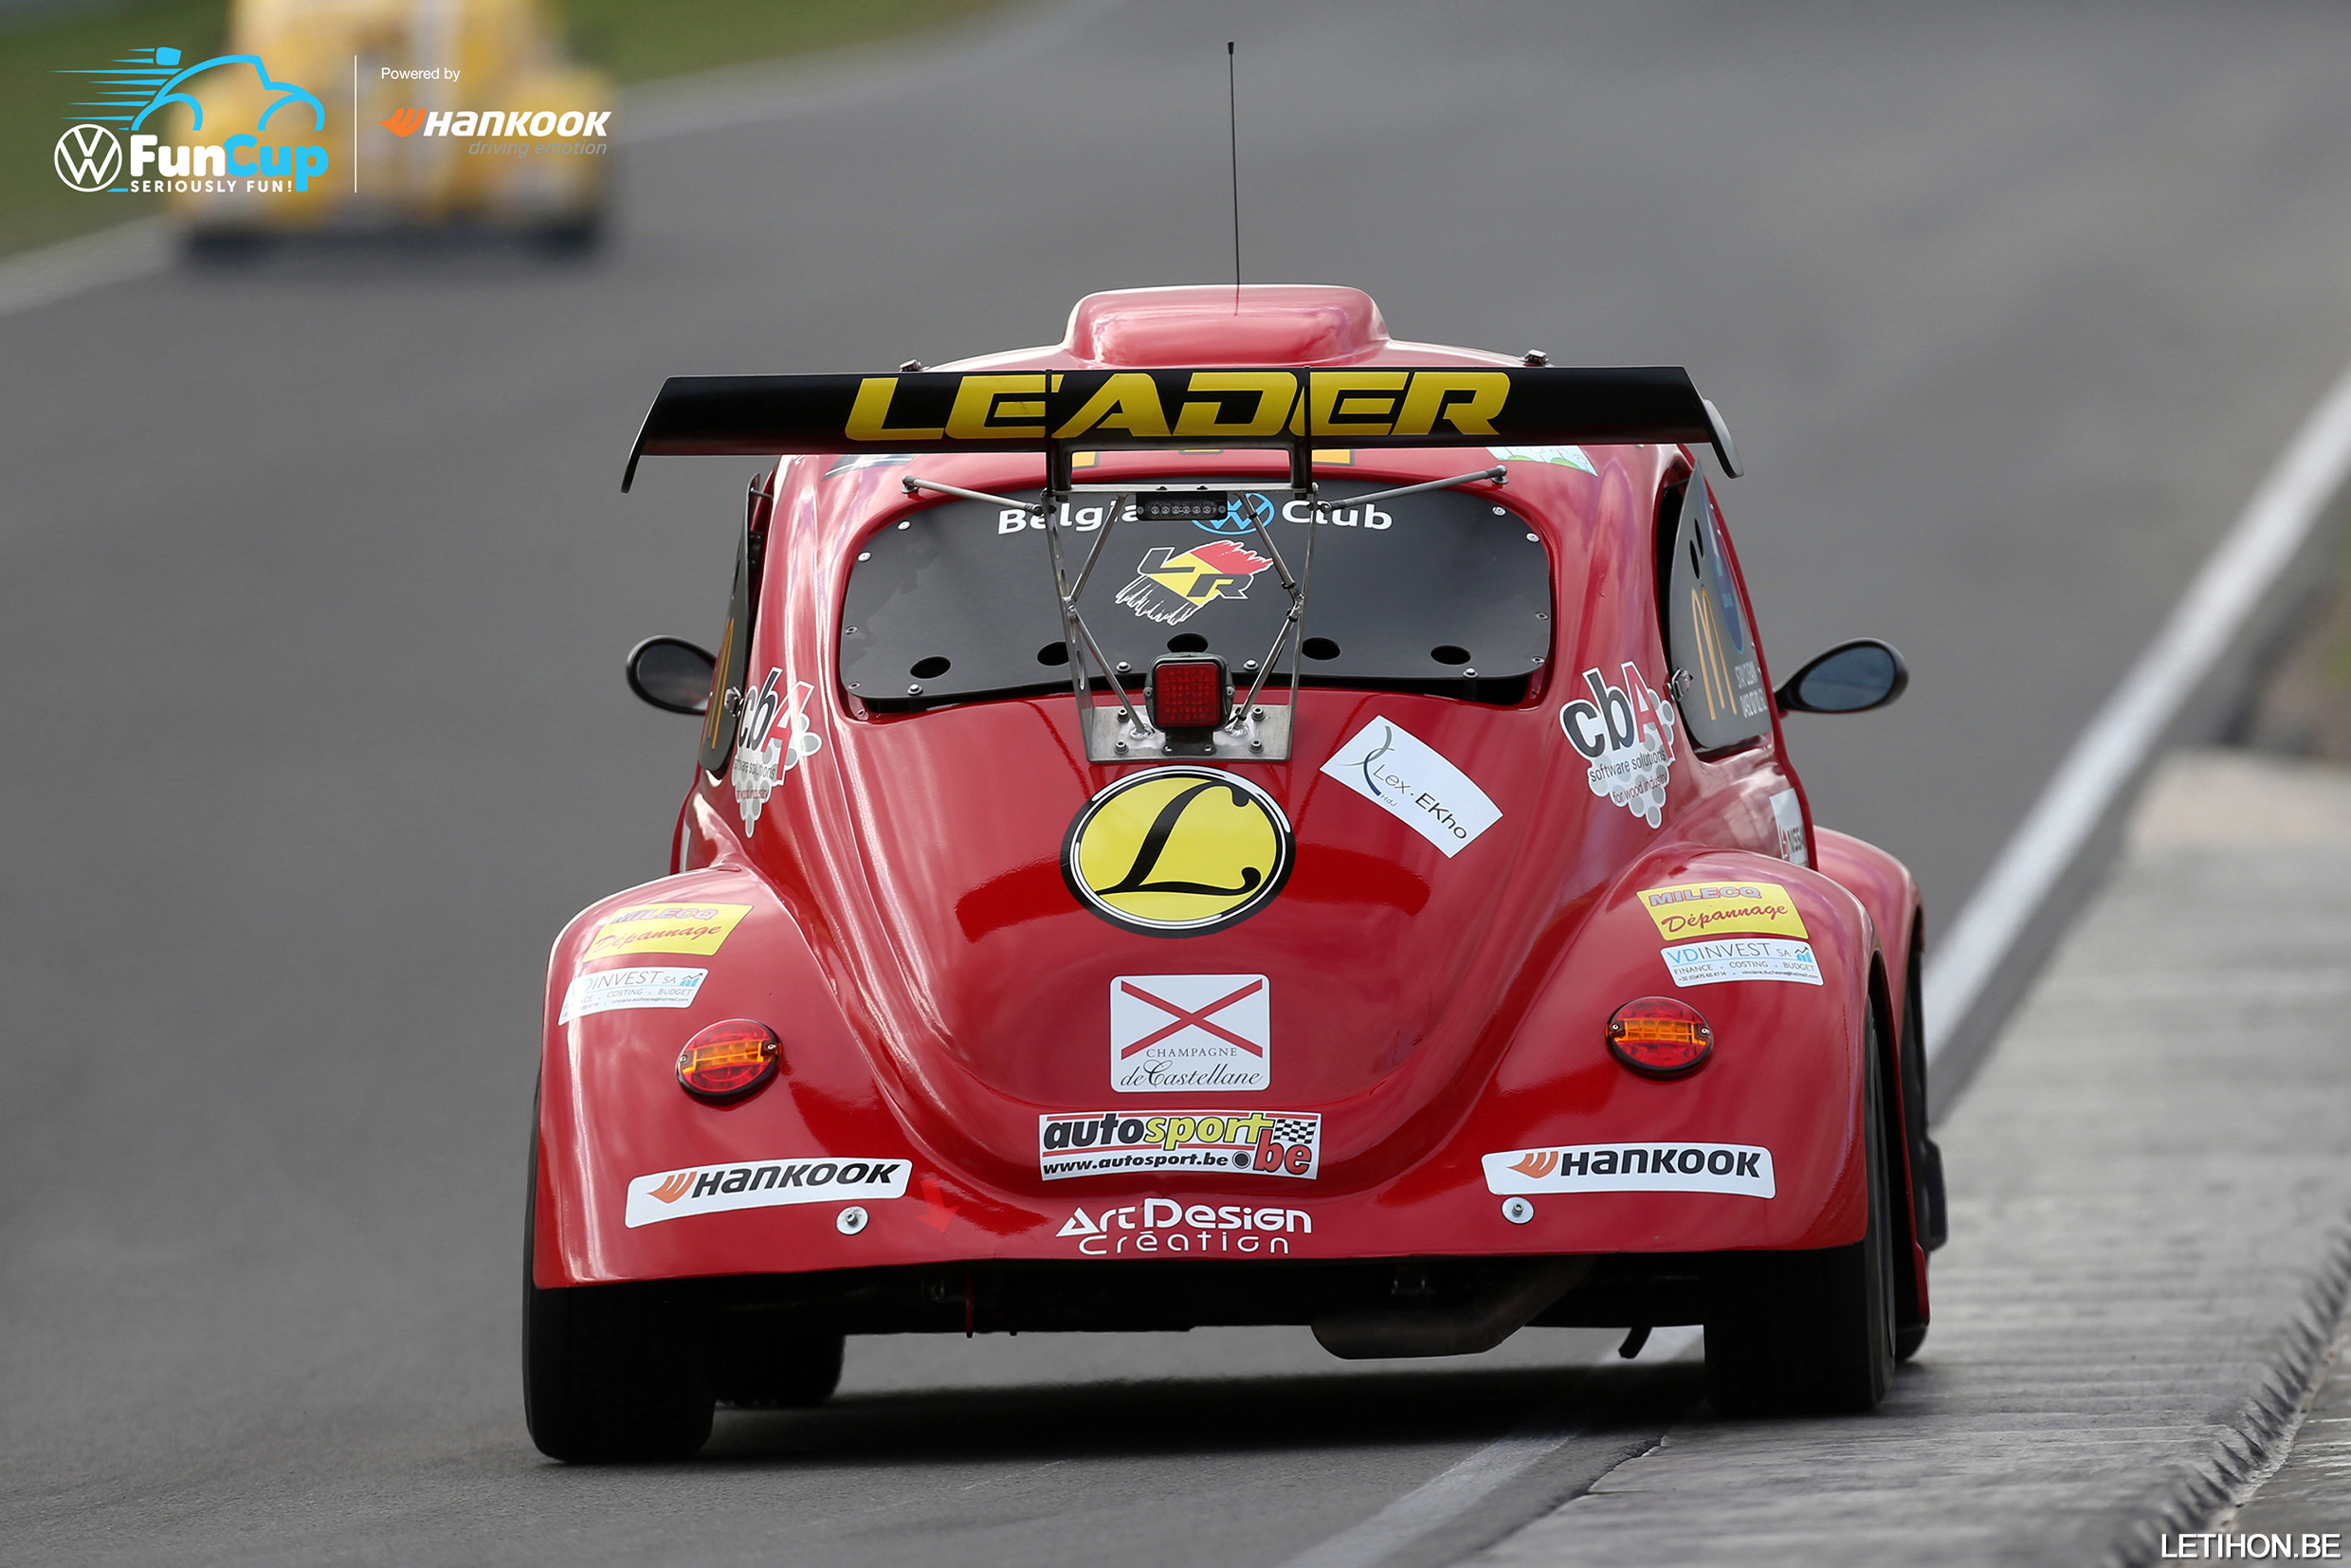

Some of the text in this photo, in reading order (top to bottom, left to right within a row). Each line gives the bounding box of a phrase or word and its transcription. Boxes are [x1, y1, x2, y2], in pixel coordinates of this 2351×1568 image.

[846, 372, 1511, 441] LEADER
[1283, 500, 1393, 529] Club
[1373, 764, 1411, 793] Lex
[1590, 749, 1667, 782] software solutions
[1613, 774, 1668, 804] for wood industry
[1649, 885, 1762, 906] MILECQ
[611, 907, 719, 925] MILECQ
[1661, 903, 1788, 934] Dépannage
[592, 924, 722, 954] Dépannage
[1667, 942, 1792, 964] VDINVEST SA
[662, 975, 676, 984] SA
[1673, 963, 1713, 975] FINANCE
[1782, 961, 1815, 972] BUDGET
[607, 988, 644, 998] COSTING
[1146, 1048, 1237, 1058] CHAMPAGNE
[1143, 1059, 1264, 1088] Castellane
[1043, 1113, 1274, 1151] autosport
[1043, 1152, 1229, 1176] www.autosport.be
